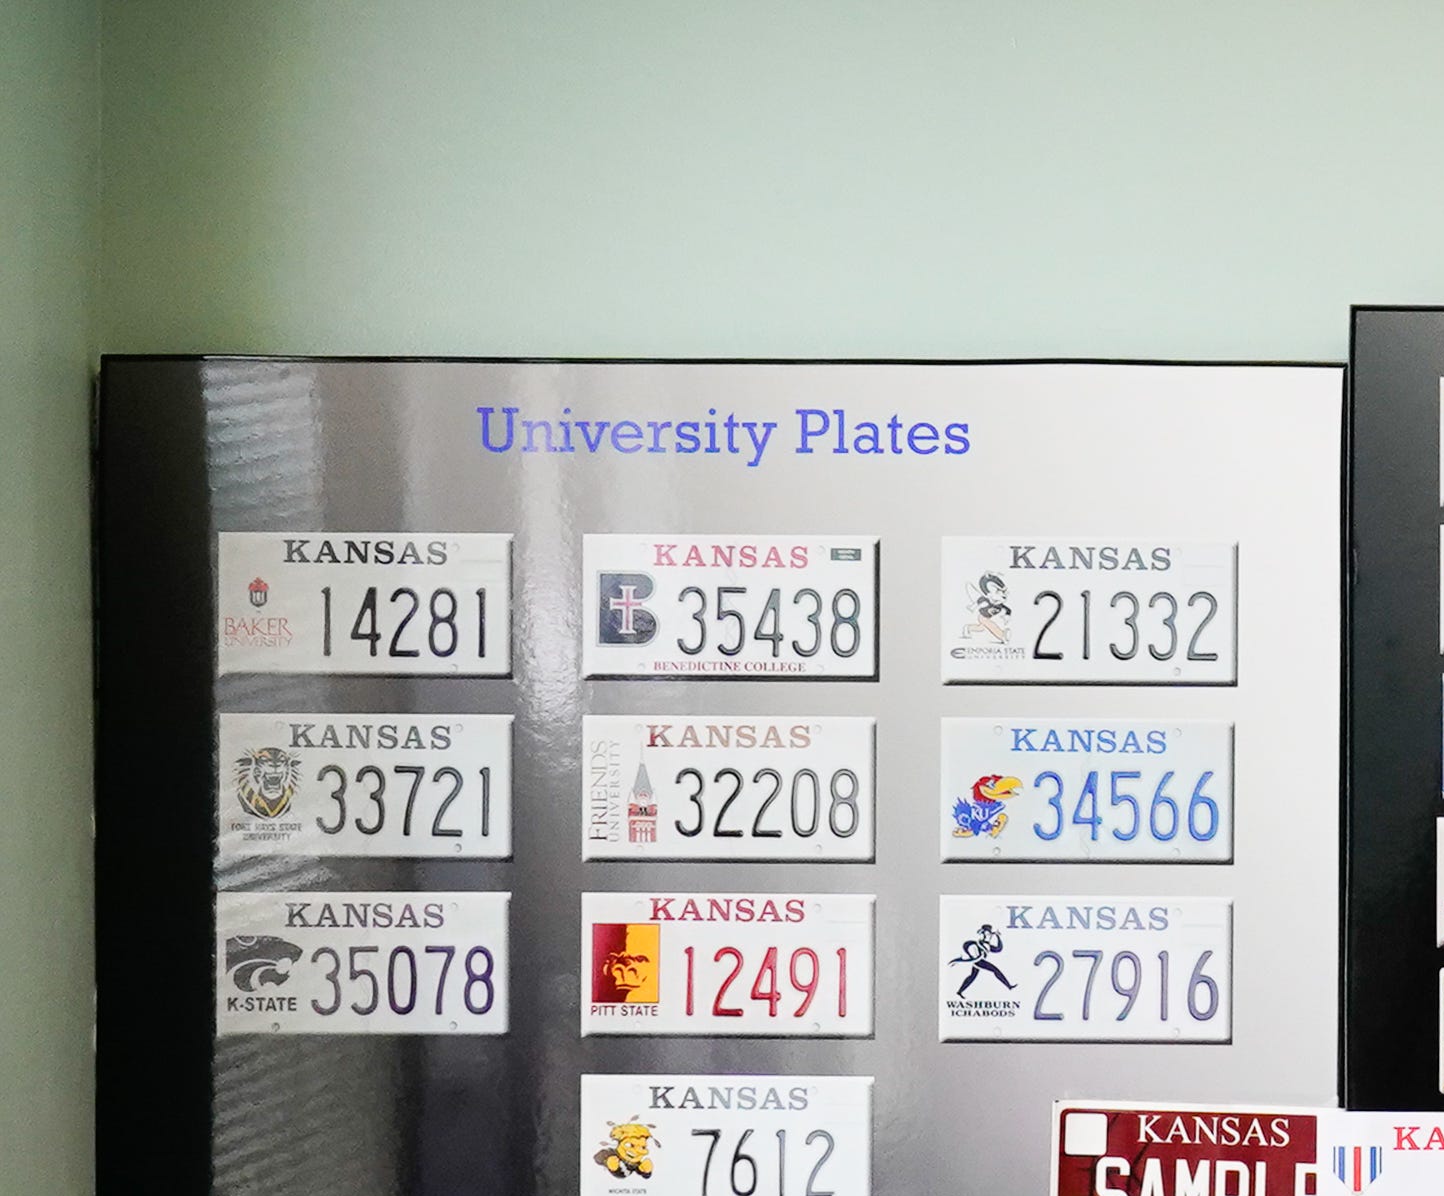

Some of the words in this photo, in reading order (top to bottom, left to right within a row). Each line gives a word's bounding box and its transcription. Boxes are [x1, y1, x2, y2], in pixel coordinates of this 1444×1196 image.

[477, 407, 777, 467] University
[796, 408, 970, 454] Plates
[653, 544, 809, 569] KANSAS
[322, 587, 486, 658] 14281
[677, 587, 862, 658] 35438
[1033, 591, 1218, 661] 21332
[653, 661, 741, 673] BENEDICTINE
[745, 661, 807, 673] COLLEGE
[289, 723, 451, 750] KANSAS
[646, 725, 810, 748] KANSAS
[316, 765, 490, 837] 33721
[674, 768, 859, 838] 32208
[1033, 771, 1219, 841] 34566
[650, 898, 805, 922] KANSAS
[1006, 906, 1169, 930] KANSAS
[227, 997, 297, 1012] K-STATE
[311, 945, 494, 1015] 35078
[685, 946, 846, 1018] 12491
[1033, 950, 1219, 1021] 27916
[591, 1005, 616, 1016] PITT
[621, 1005, 658, 1016] STATE
[1137, 1114, 1290, 1147] KANSAS
